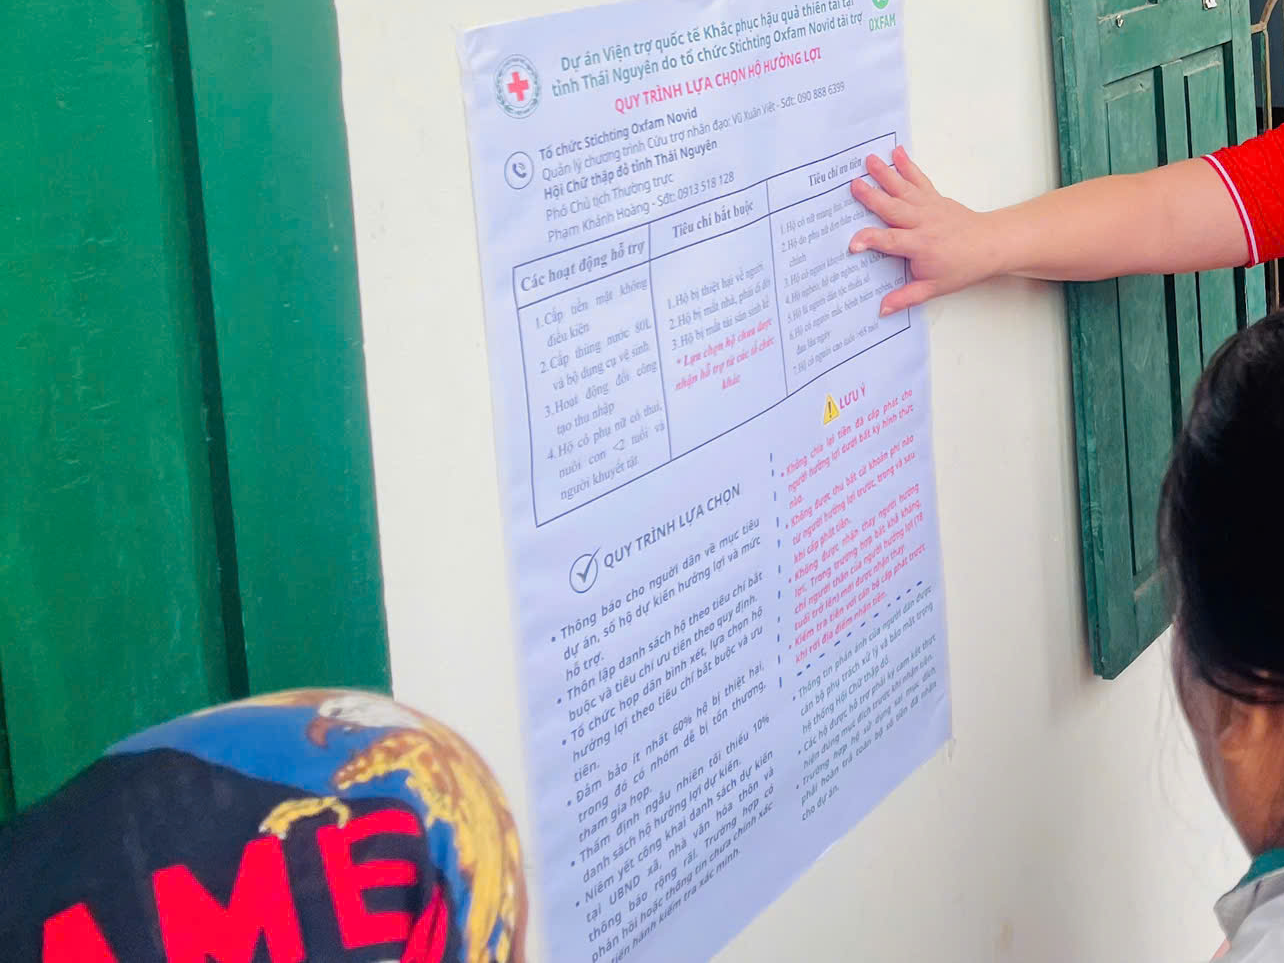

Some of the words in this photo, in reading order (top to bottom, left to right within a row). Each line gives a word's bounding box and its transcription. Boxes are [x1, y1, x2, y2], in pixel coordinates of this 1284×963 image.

[660, 54, 678, 70] do
[728, 33, 771, 55] Stichting
[772, 25, 806, 43] Oxfam
[807, 15, 835, 35] Novid
[867, 12, 896, 32] OXFAM
[614, 92, 640, 114] QUY
[641, 82, 683, 105] TRÌNH
[684, 75, 713, 95] LỰA
[714, 66, 746, 87] CHỌN
[762, 50, 802, 73] HƯỞNG
[583, 126, 630, 148] Stichting
[630, 117, 665, 135] Oxfam
[665, 105, 698, 125] Novid
[603, 540, 632, 569] QUY
[634, 518, 675, 551] TRÌNH
[678, 503, 705, 528] LỰA
[706, 482, 740, 512] CHỌN
[625, 585, 645, 603] cho
[608, 873, 640, 905] UBND
